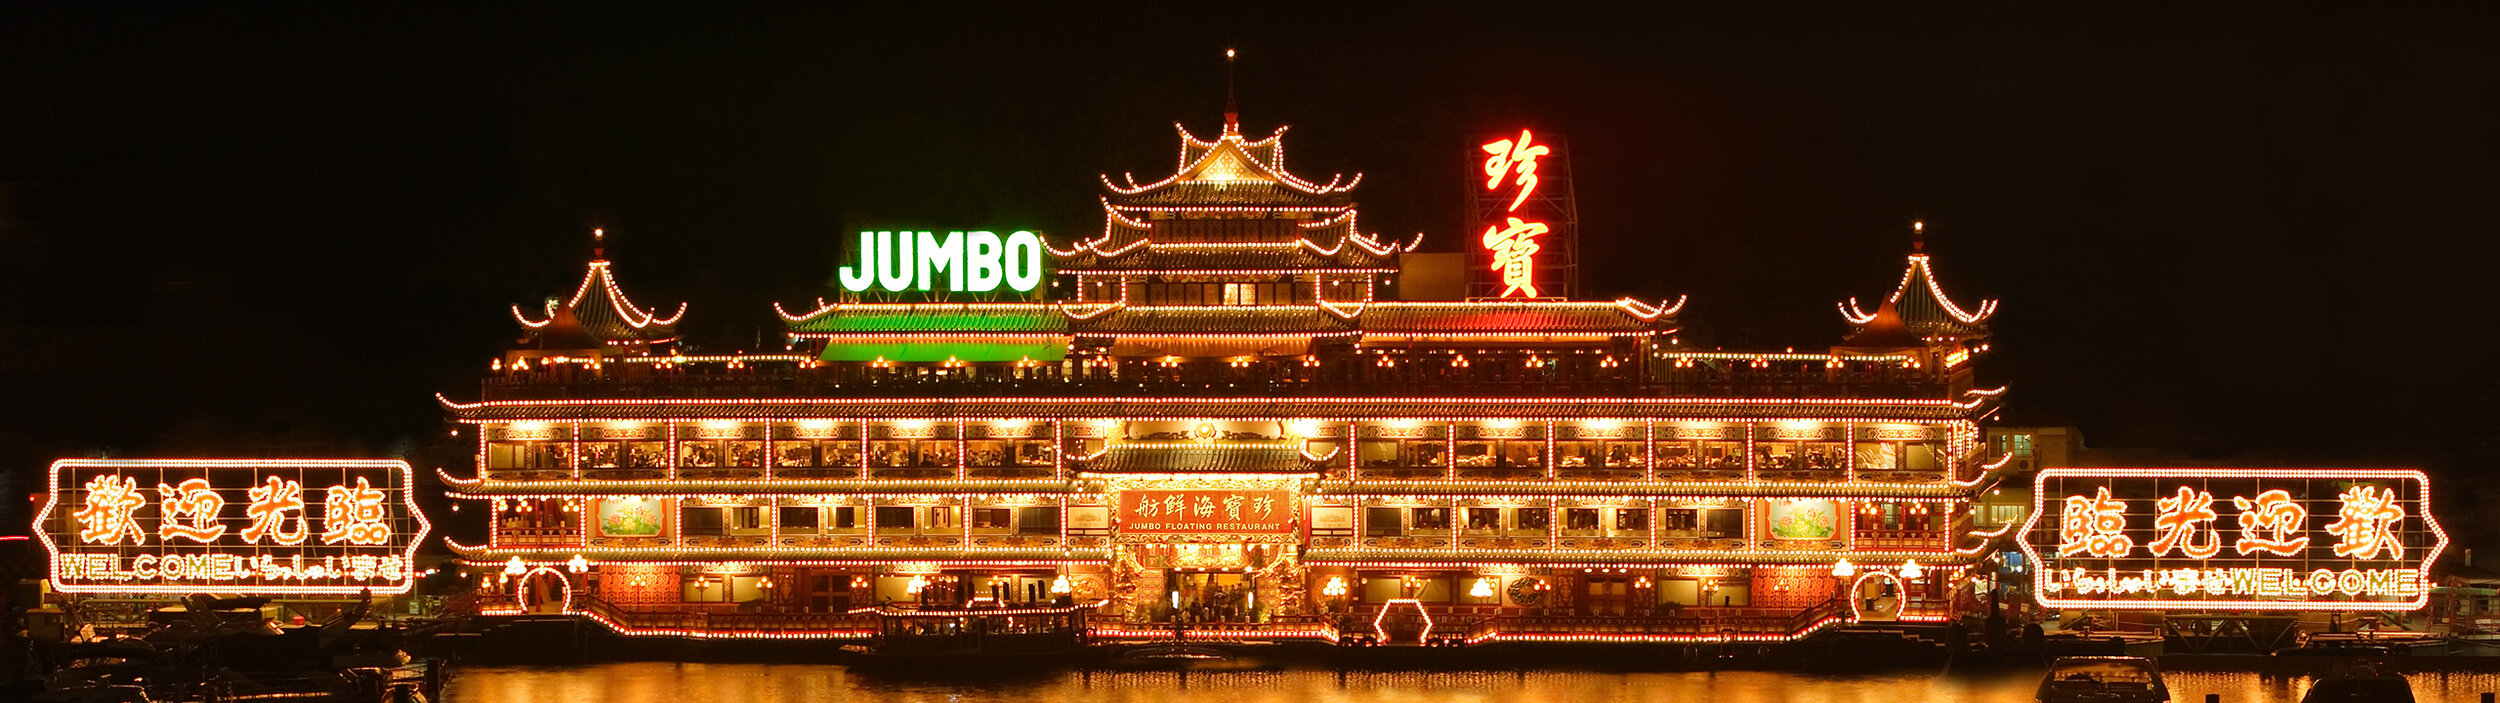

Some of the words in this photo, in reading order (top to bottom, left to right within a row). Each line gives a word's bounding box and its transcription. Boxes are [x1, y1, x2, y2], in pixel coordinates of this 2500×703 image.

[1482, 129, 1550, 299] 珍寶
[839, 230, 1042, 292] JUMBO
[72, 474, 392, 546] 歡迎光臨
[1129, 522, 1161, 530] JUMBO
[1165, 522, 1212, 530] FLOATING
[1216, 522, 1281, 530] RESTAURANT
[59, 553, 234, 581] WELCOME
[2230, 567, 2421, 597] WELCOME
